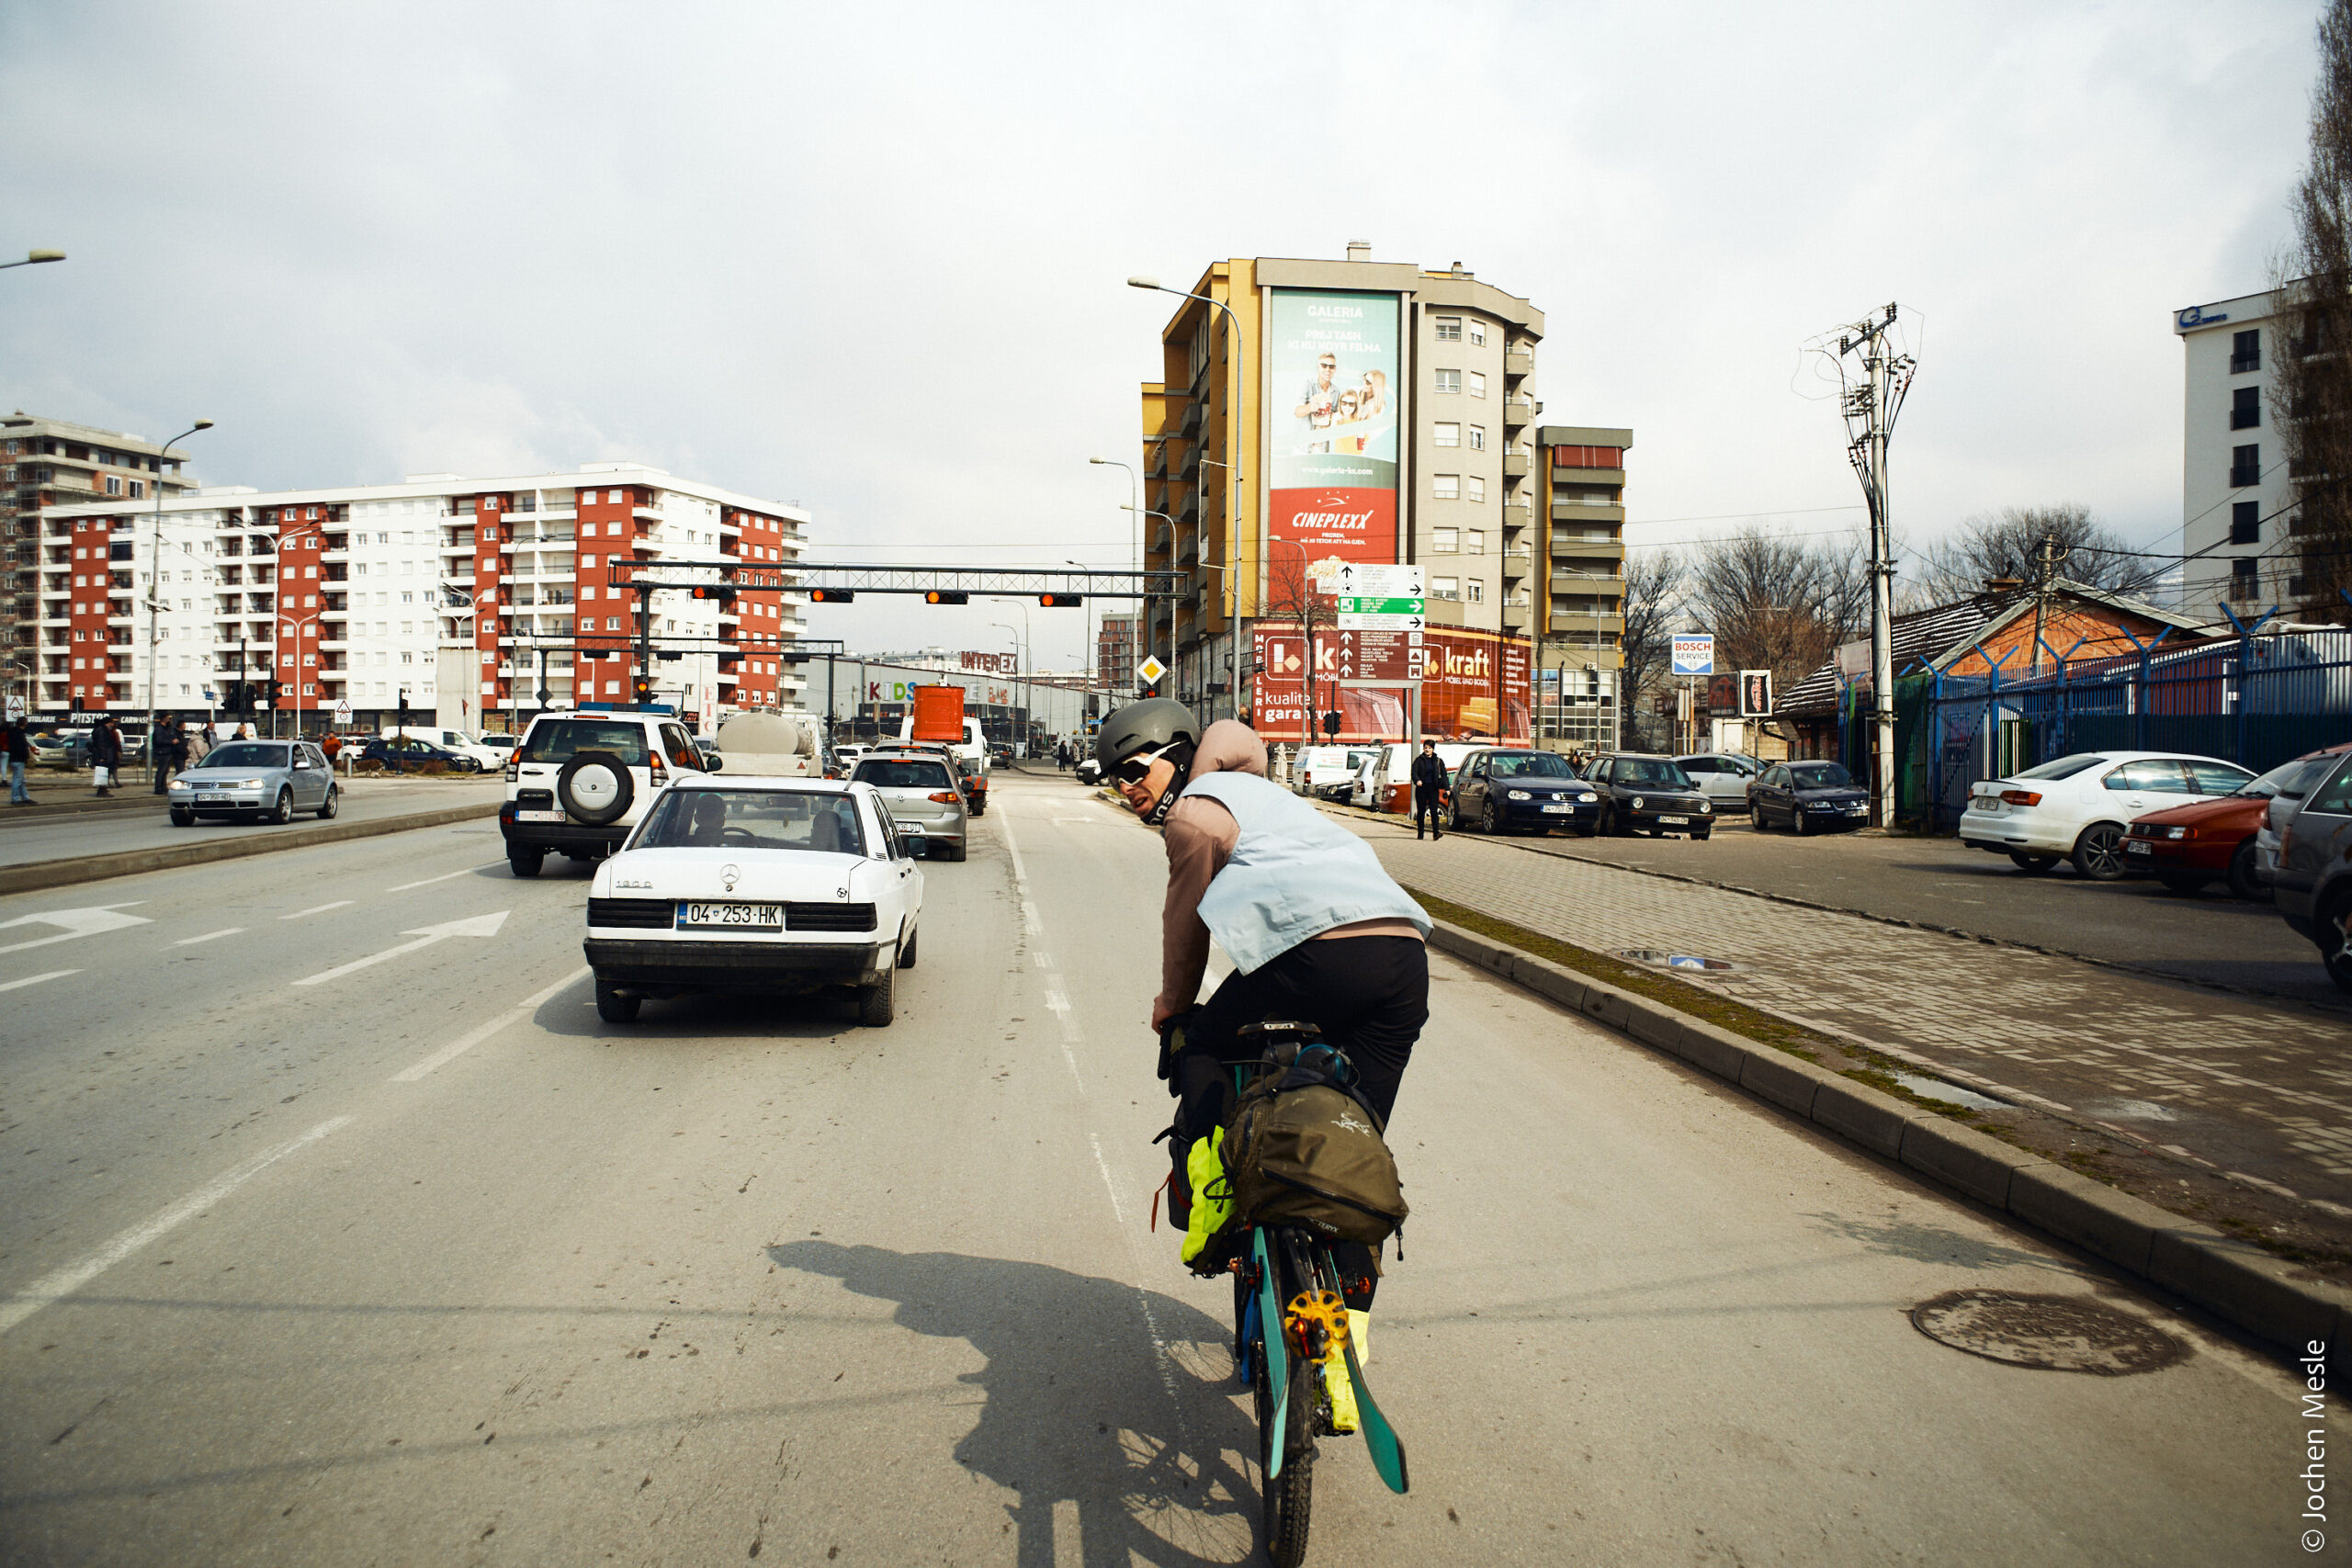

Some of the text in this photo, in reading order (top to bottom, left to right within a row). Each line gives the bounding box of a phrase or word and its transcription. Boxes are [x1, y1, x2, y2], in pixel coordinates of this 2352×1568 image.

[1307, 305, 1363, 318] GALERIA
[1333, 330, 1362, 341] TASH
[1350, 342, 1382, 354] FILMA
[1292, 509, 1374, 529] CINEPLEXX
[1675, 642, 1711, 651] BOSCH
[1445, 646, 1489, 677] kraft
[1676, 652, 1711, 660] SERVICE
[1255, 634, 1264, 716] MOBLERI
[869, 682, 917, 701] KIDS
[26, 715, 56, 723] UTOLARJE
[691, 905, 710, 922] 04
